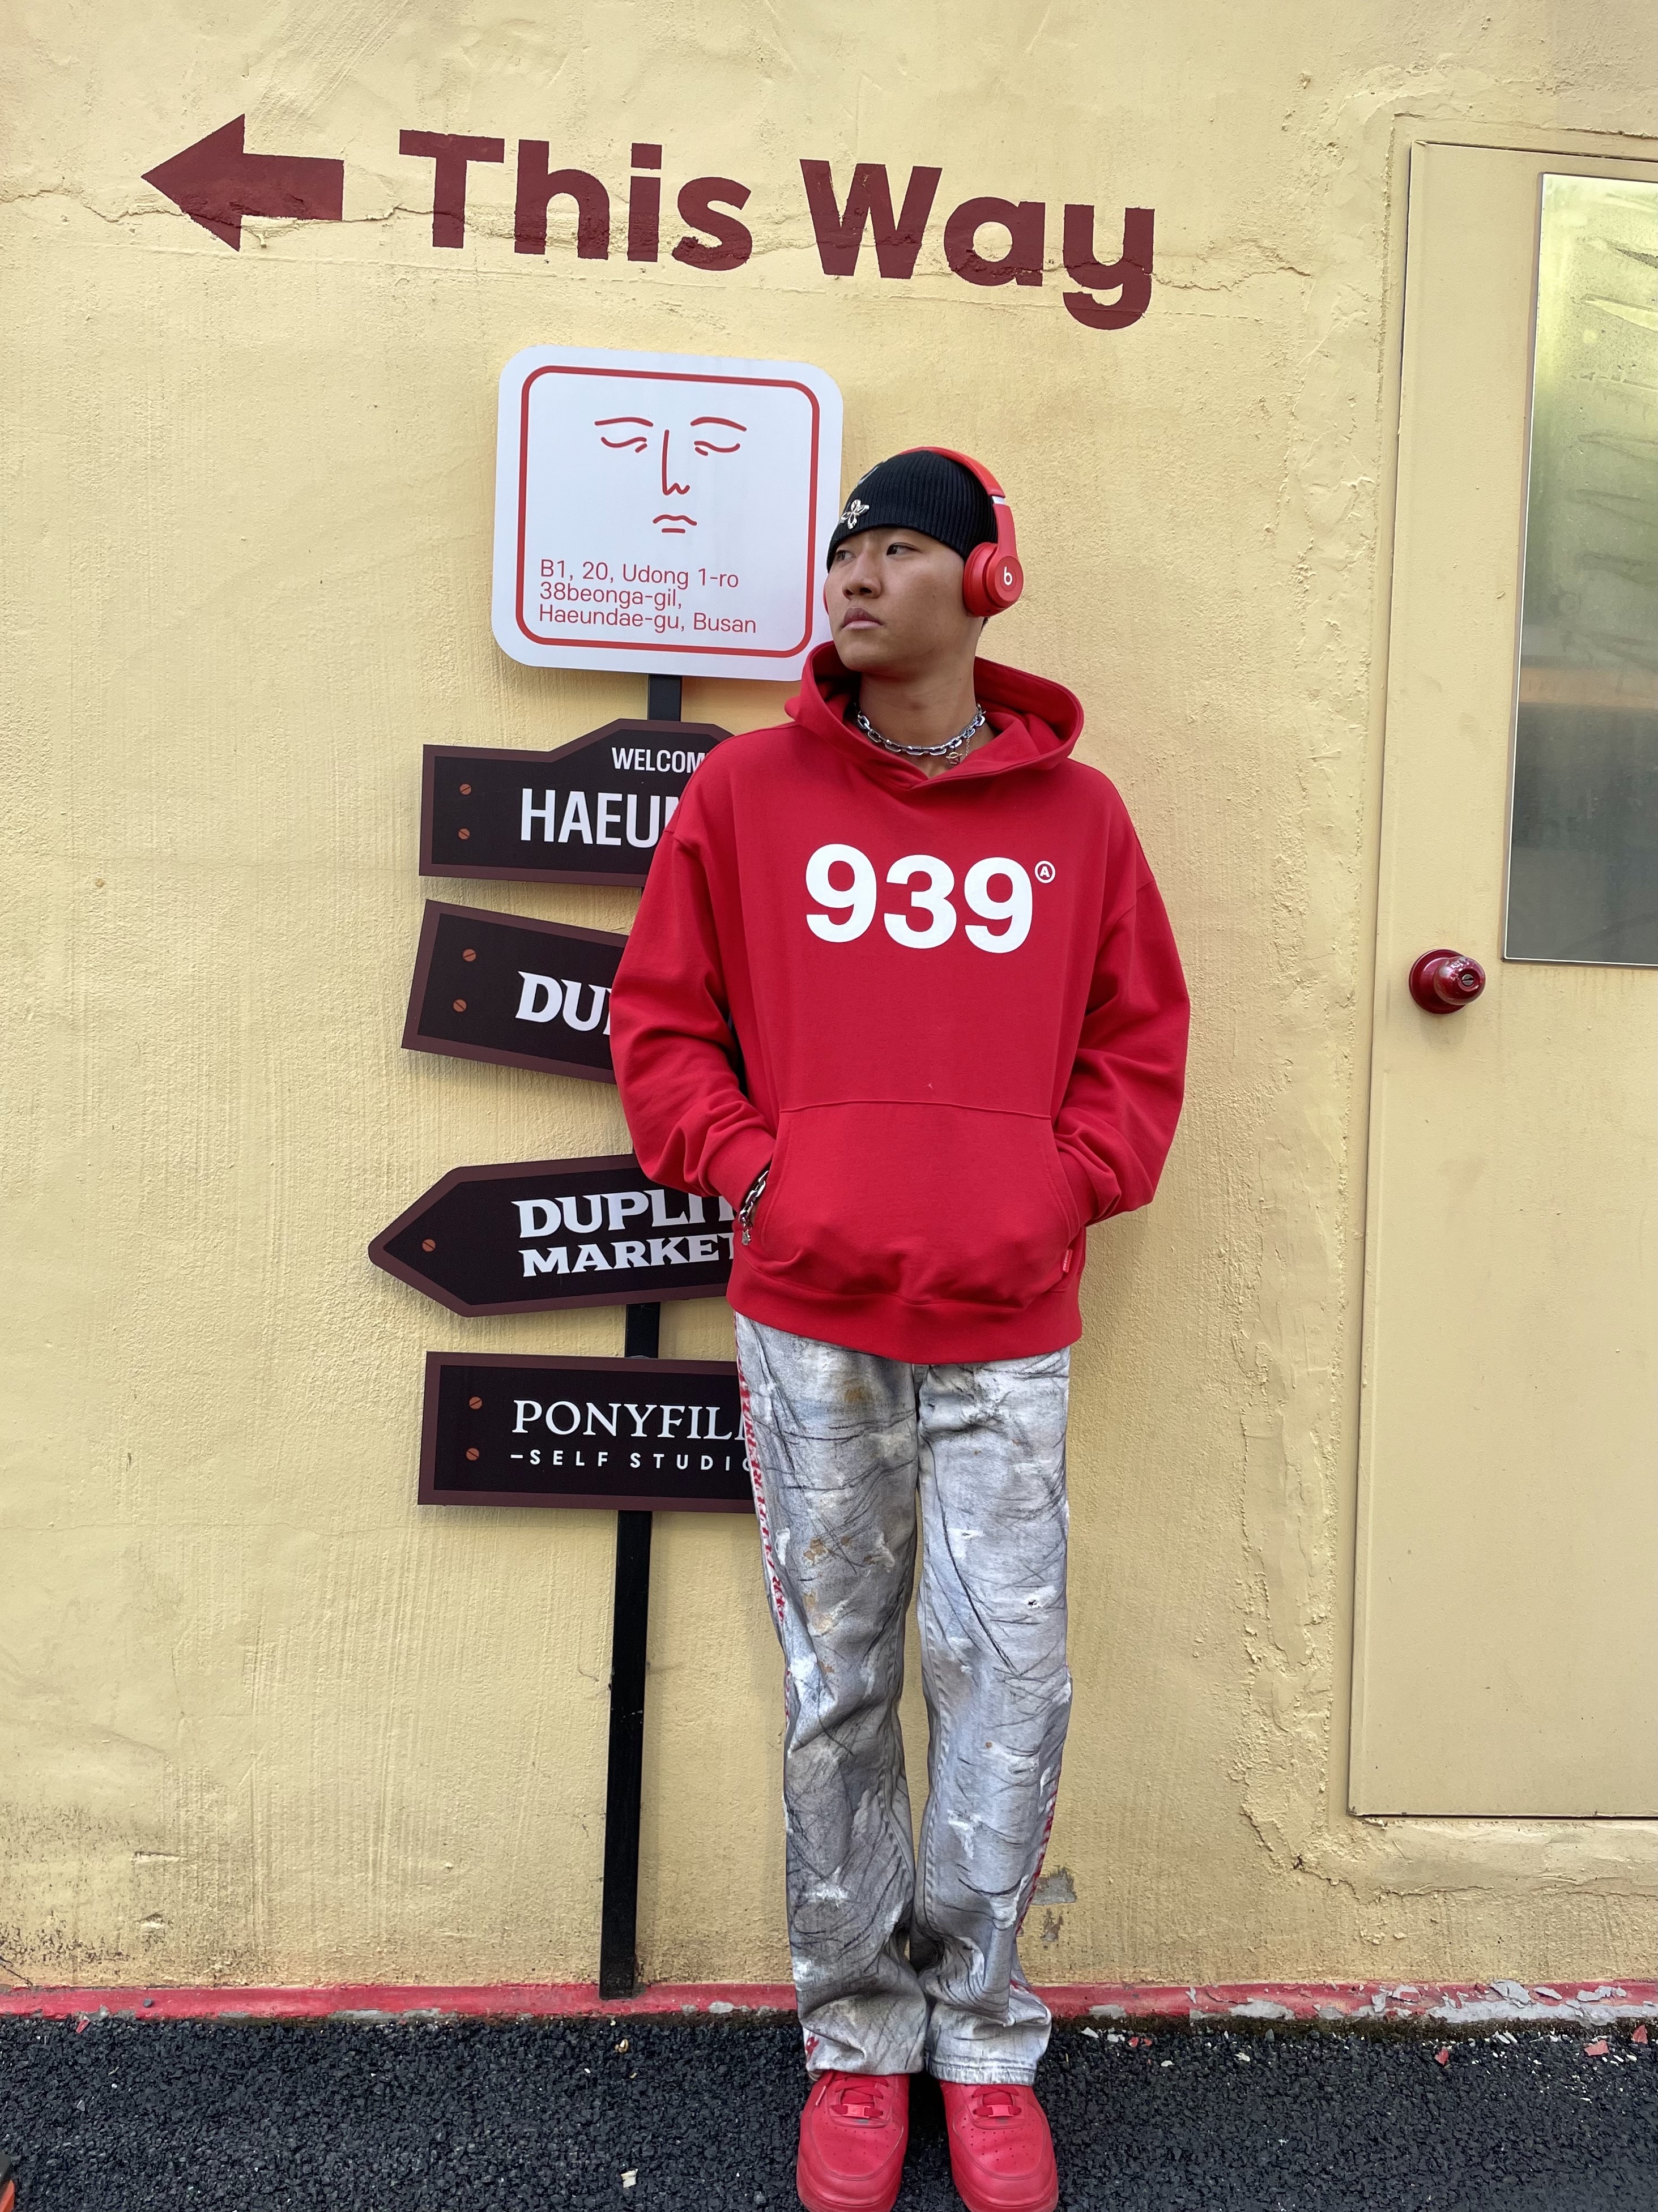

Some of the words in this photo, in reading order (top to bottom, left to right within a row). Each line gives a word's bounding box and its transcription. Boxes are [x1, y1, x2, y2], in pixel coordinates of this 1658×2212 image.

[399, 130, 752, 271] This
[800, 159, 1155, 330] Way
[540, 559, 573, 580] B1,
[582, 561, 614, 583] 20,
[623, 563, 688, 590] Udong
[698, 568, 739, 587] 1-ro
[540, 582, 682, 610] 38beonga-gil,
[539, 604, 685, 633] Haeundae-gu,
[694, 612, 757, 633] Busan
[612, 748, 707, 773] WELCOM
[806, 844, 1032, 954] 939
[515, 971, 612, 1035] DU
[512, 1400, 745, 1441] PONYFIL
